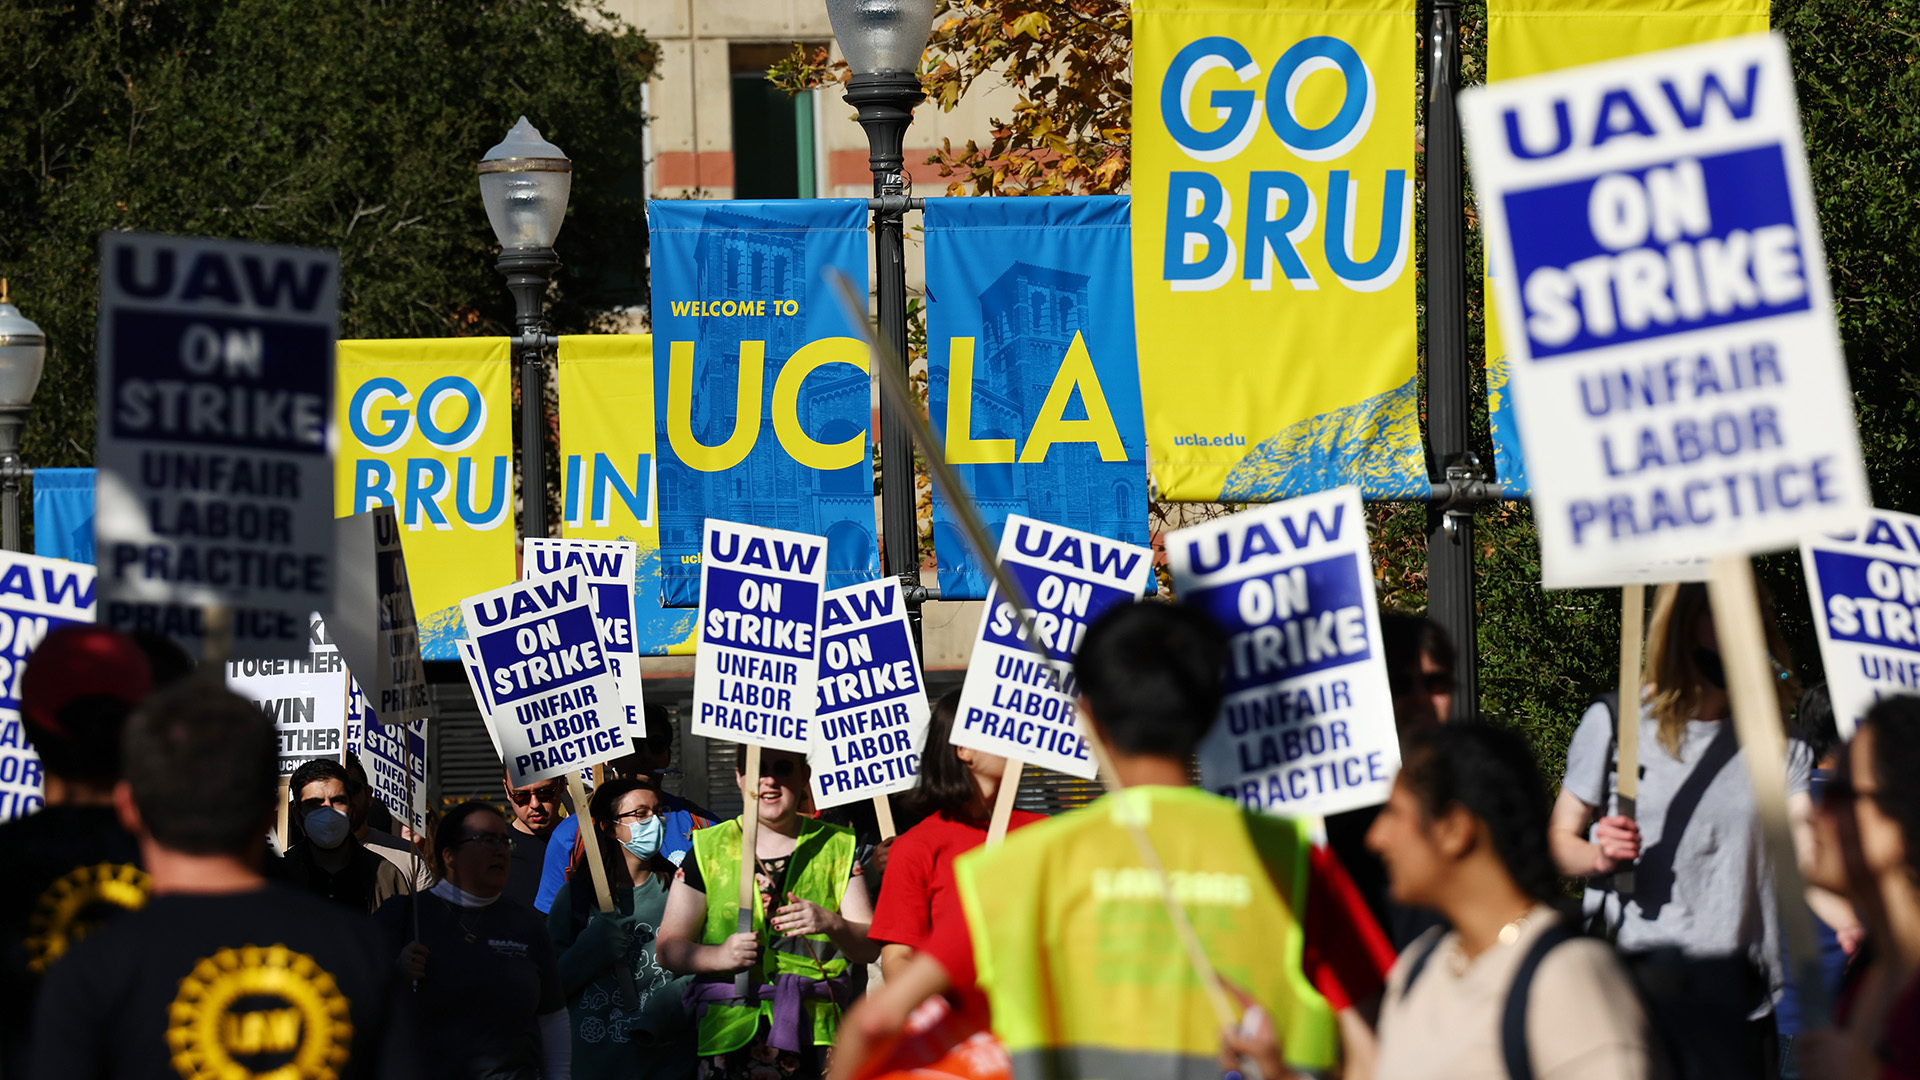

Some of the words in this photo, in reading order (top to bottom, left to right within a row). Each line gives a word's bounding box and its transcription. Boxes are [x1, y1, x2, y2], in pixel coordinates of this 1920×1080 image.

[1160, 36, 1376, 162] GO
[1503, 65, 1760, 160] UAW
[1588, 157, 1711, 251] ON
[1162, 169, 1414, 292] BRU
[115, 245, 331, 313] UAW
[1525, 224, 1806, 345] STRIKE
[671, 300, 765, 317] WELCOME
[773, 300, 799, 316] TO
[180, 323, 264, 378] ON
[1577, 341, 1785, 420] UNFAIR
[118, 378, 325, 444] STRIKE
[349, 376, 487, 454] GO
[1174, 433, 1246, 447] ucla.edu
[1602, 406, 1783, 478] LABOR
[142, 452, 300, 498] UNFAIR
[353, 456, 513, 531] BRU
[564, 452, 656, 528] IN
[152, 498, 292, 544] LABOR
[1567, 455, 1839, 548] PRACTICE
[710, 530, 821, 576] UAW
[1015, 524, 1141, 580] UAW
[1188, 504, 1345, 577] UAW
[0, 563, 97, 609] AW
[113, 543, 329, 593] PRACTICE
[536, 550, 623, 578] UAW
[474, 575, 578, 628] UAW
[739, 578, 783, 613] ON
[822, 585, 895, 631] AW
[1037, 575, 1093, 617] ON
[1238, 566, 1309, 626] ON
[109, 602, 298, 639] PRACICE
[516, 619, 561, 656] ON
[706, 607, 814, 653] STRIKE
[990, 602, 1088, 654] STRI
[1230, 606, 1368, 681] TRIKE
[229, 652, 342, 678] TOGETHER
[493, 640, 601, 695] STRIKE
[717, 651, 798, 686] UNFAIR
[826, 634, 873, 670] ON
[719, 679, 792, 712] LABOR
[995, 655, 1080, 698] UNFAI
[252, 697, 315, 724] WIN
[515, 684, 598, 726] UNFAIR
[700, 703, 809, 741] PRACTICE
[821, 703, 910, 741] UNFAIR
[992, 684, 1077, 727] LABOR
[1225, 680, 1352, 737] UNFAIR
[278, 729, 341, 752] ETHER
[515, 726, 625, 777] PRACTICE
[526, 709, 601, 748] LABOR
[832, 729, 912, 766] LABOR
[964, 707, 1091, 760] PRACTICE
[1238, 720, 1351, 773] LABOR
[367, 729, 424, 777] STRIKE
[374, 757, 416, 794] UNFAIR
[819, 753, 920, 796] PRACTIC
